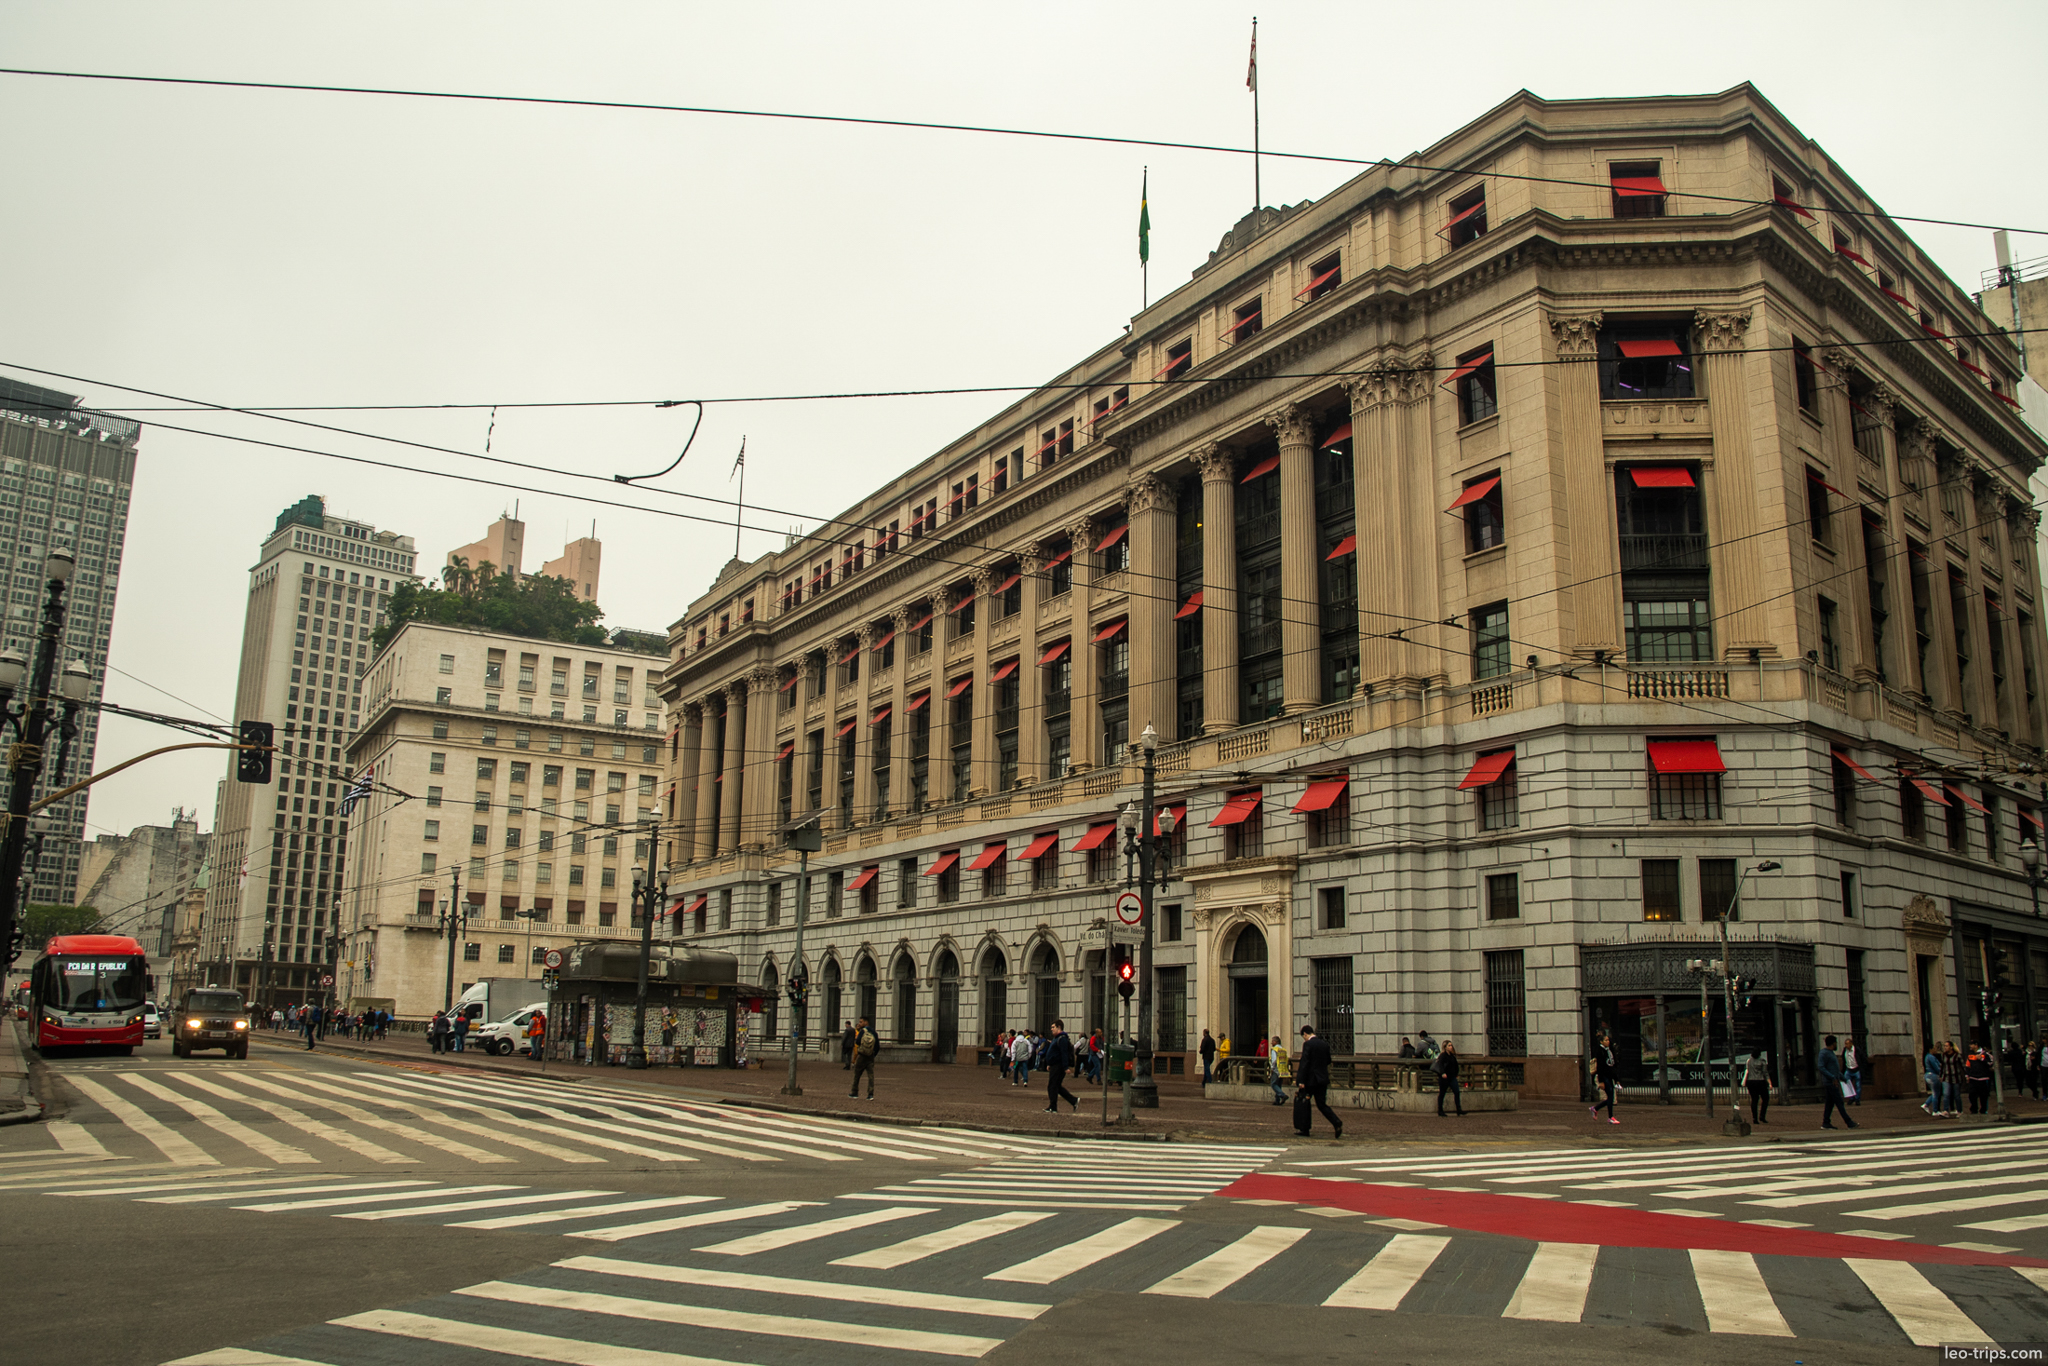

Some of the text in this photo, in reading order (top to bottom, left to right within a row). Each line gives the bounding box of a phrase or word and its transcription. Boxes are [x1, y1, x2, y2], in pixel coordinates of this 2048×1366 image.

[1095, 930, 1105, 939] Chá
[1114, 925, 1145, 935] Xavier Toledo
[81, 962, 90, 970] DA
